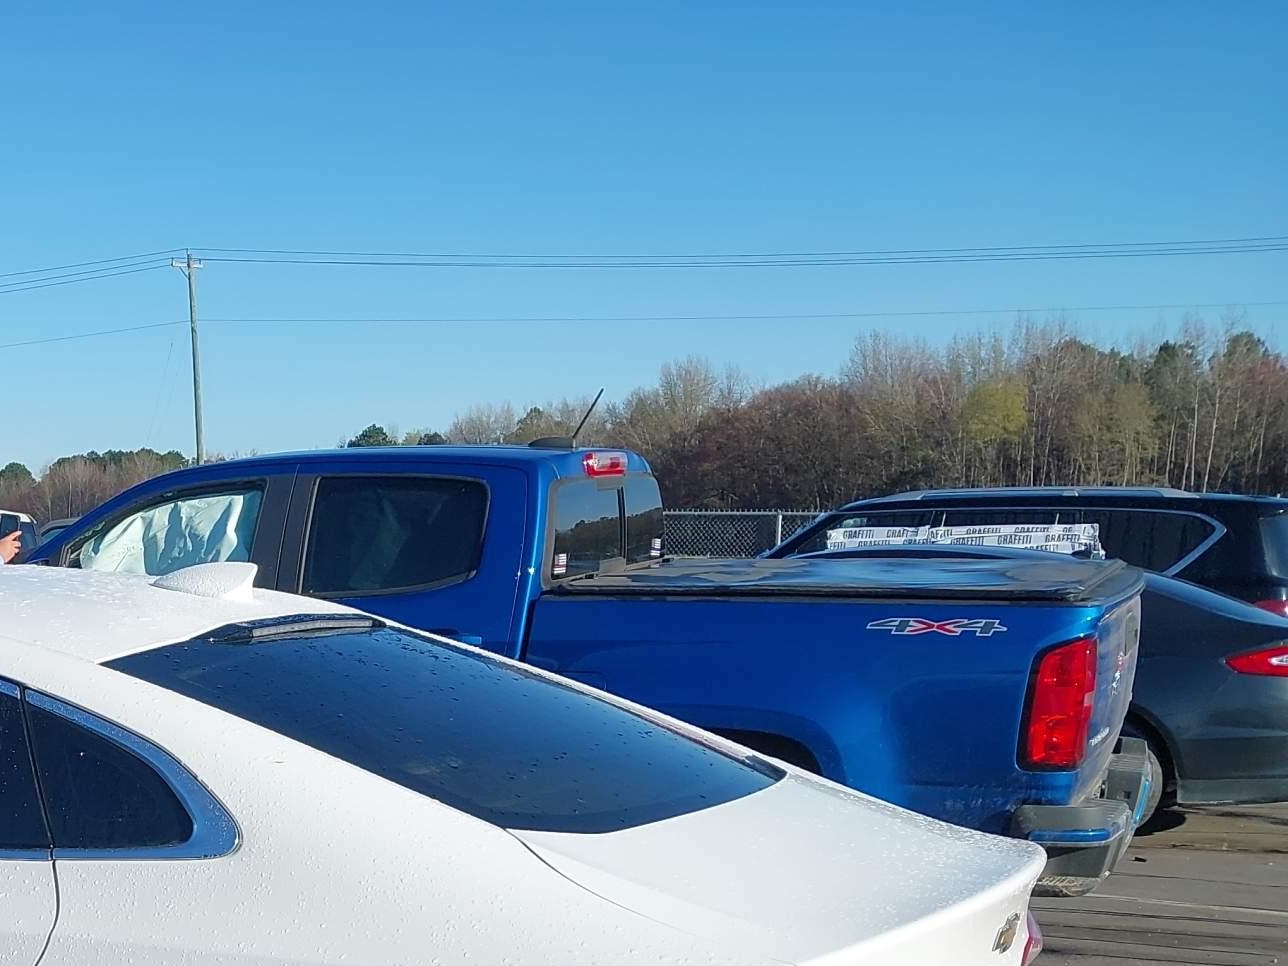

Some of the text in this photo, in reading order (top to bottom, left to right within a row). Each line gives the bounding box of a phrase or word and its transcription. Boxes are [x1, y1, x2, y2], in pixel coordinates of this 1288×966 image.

[843, 529, 874, 539] GRAFFITI
[997, 534, 1032, 545] GRAFFITI
[1045, 533, 1080, 543] GRAFFITI
